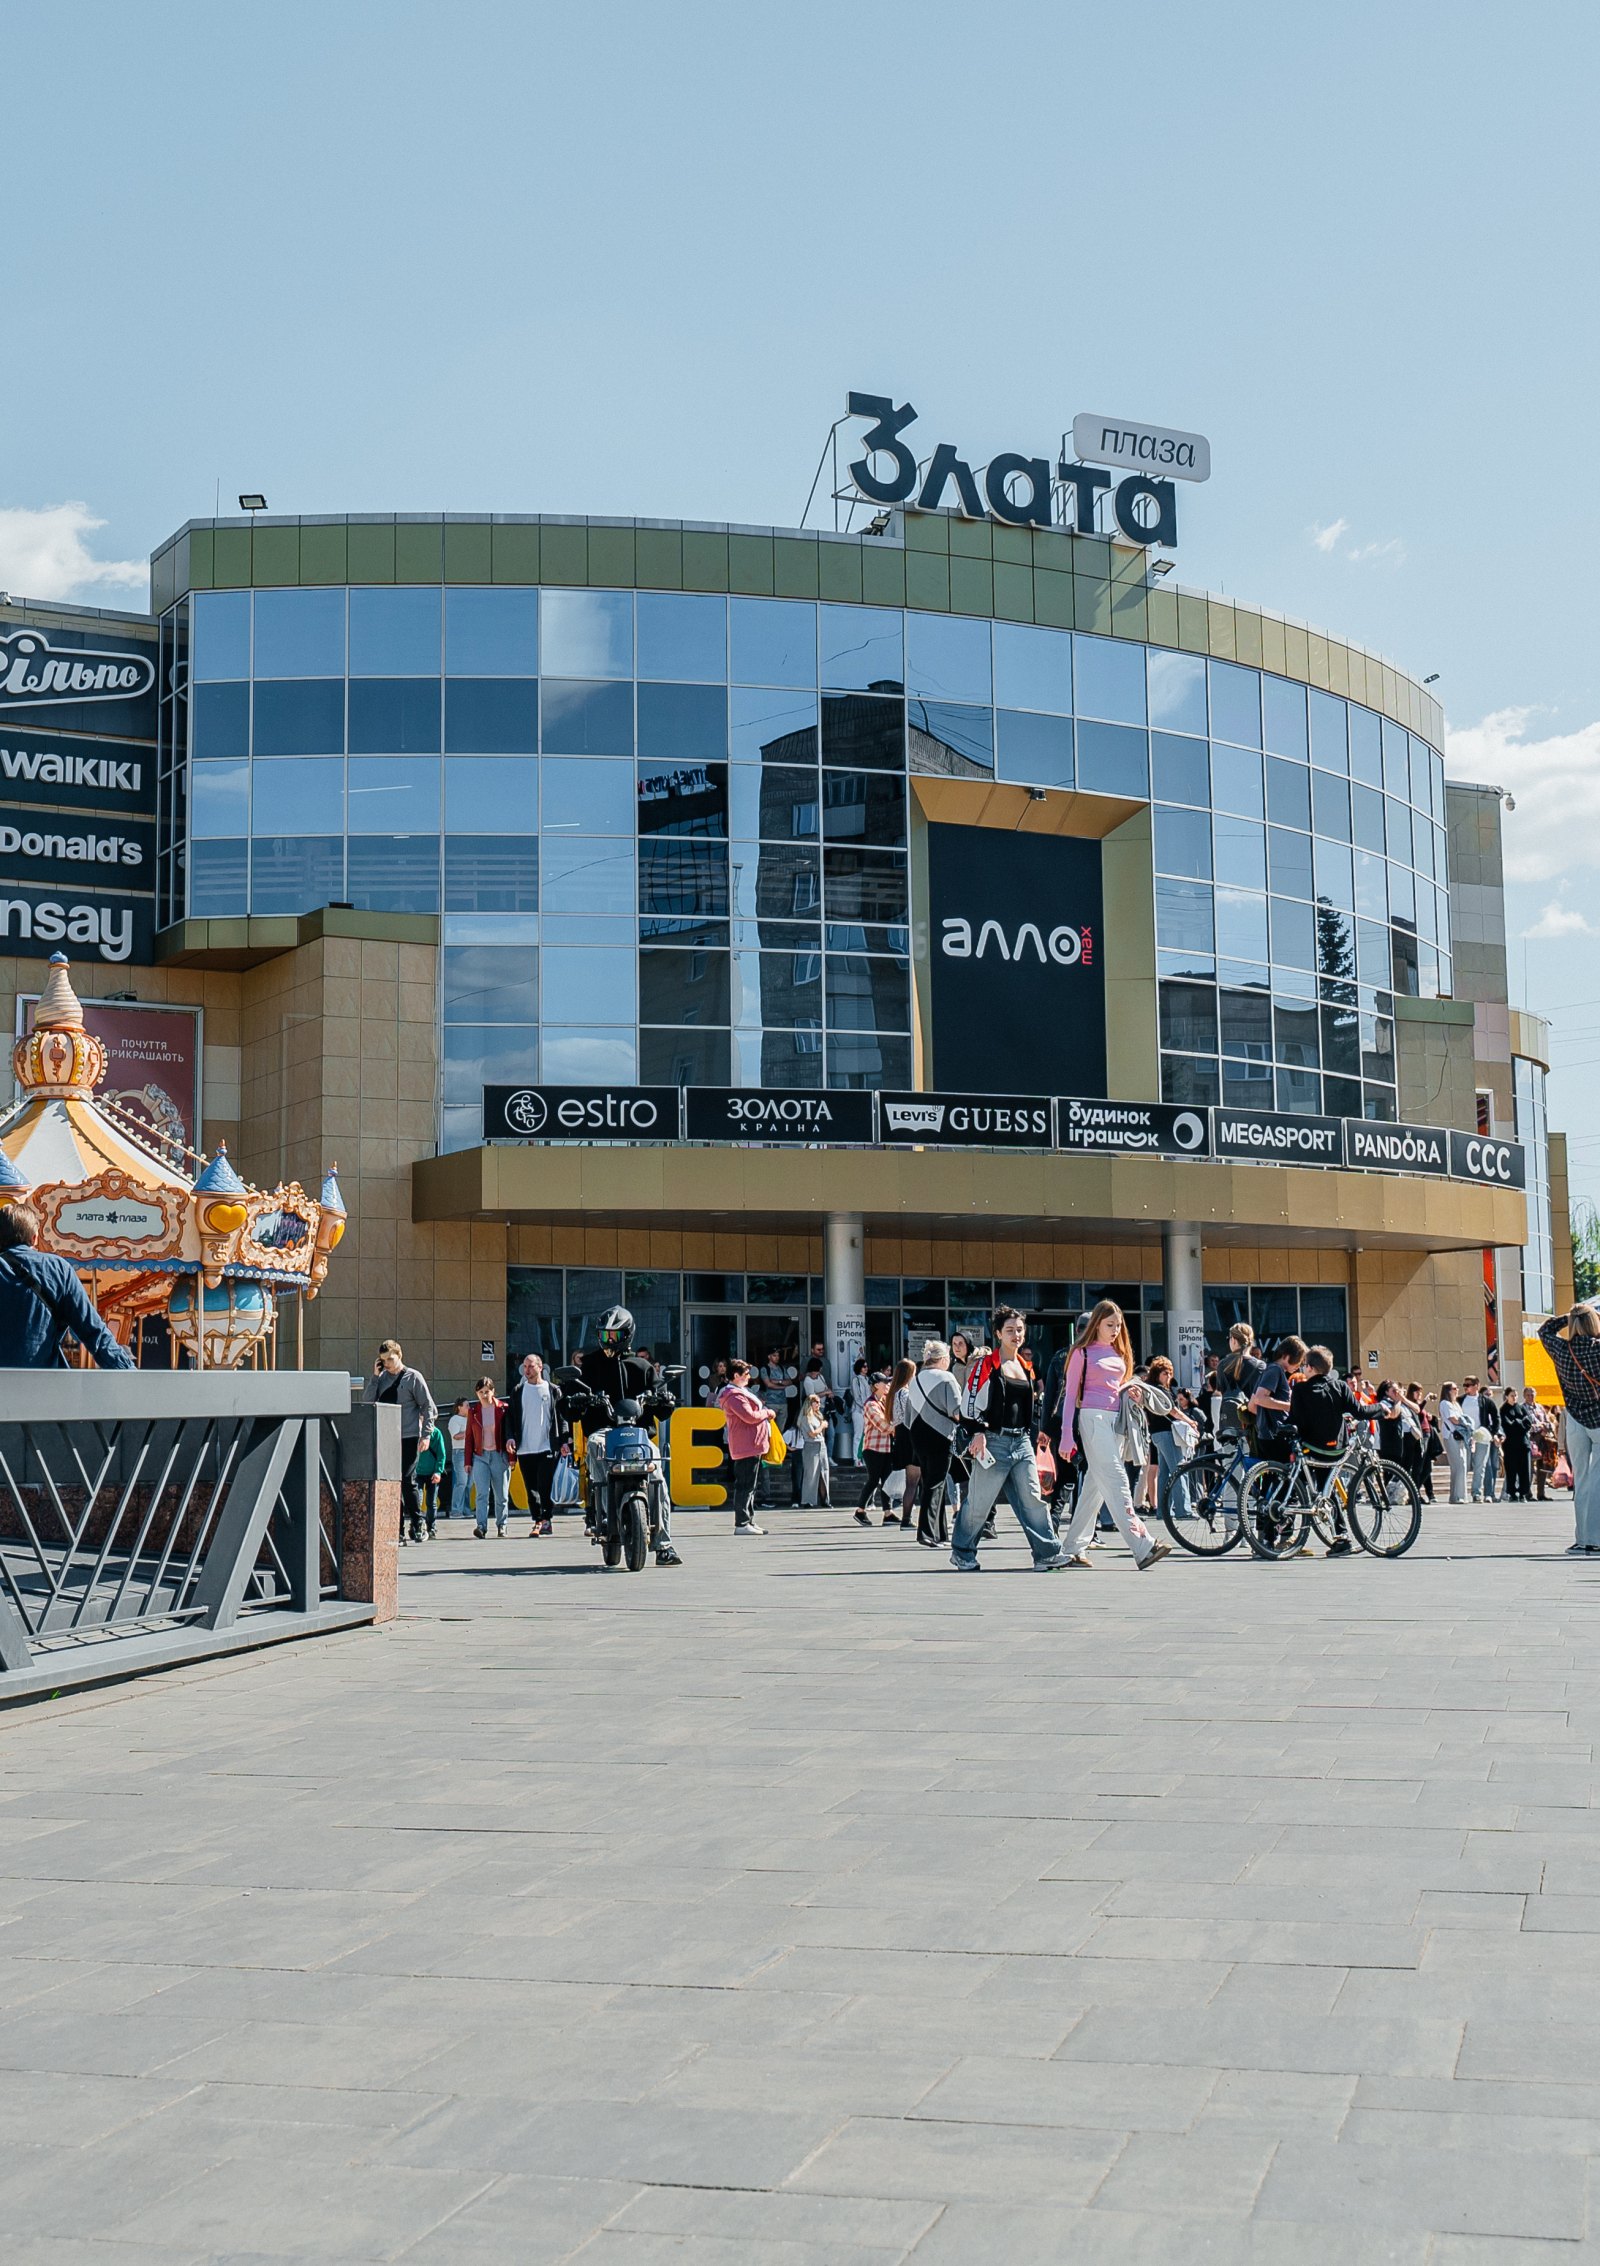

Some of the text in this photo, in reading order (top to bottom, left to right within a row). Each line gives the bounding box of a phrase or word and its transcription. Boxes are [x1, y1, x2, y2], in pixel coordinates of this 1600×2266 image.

[1100, 427, 1196, 468] плаза
[847, 390, 1177, 548] Злата
[0, 638, 141, 694] ільпо
[105, 1049, 184, 1063] ПРИКРАШАЮТЬ
[121, 1039, 167, 1050] ПОЧУТТЯ
[557, 1094, 658, 1128] estro
[727, 1098, 833, 1121] ЗОЛОТА
[950, 1106, 1047, 1134] GUESS
[1069, 1101, 1150, 1127] будинок
[1221, 1121, 1336, 1151] MEGASPORT
[1355, 1130, 1441, 1164] PANDORA
[1466, 1140, 1511, 1180] CCC
